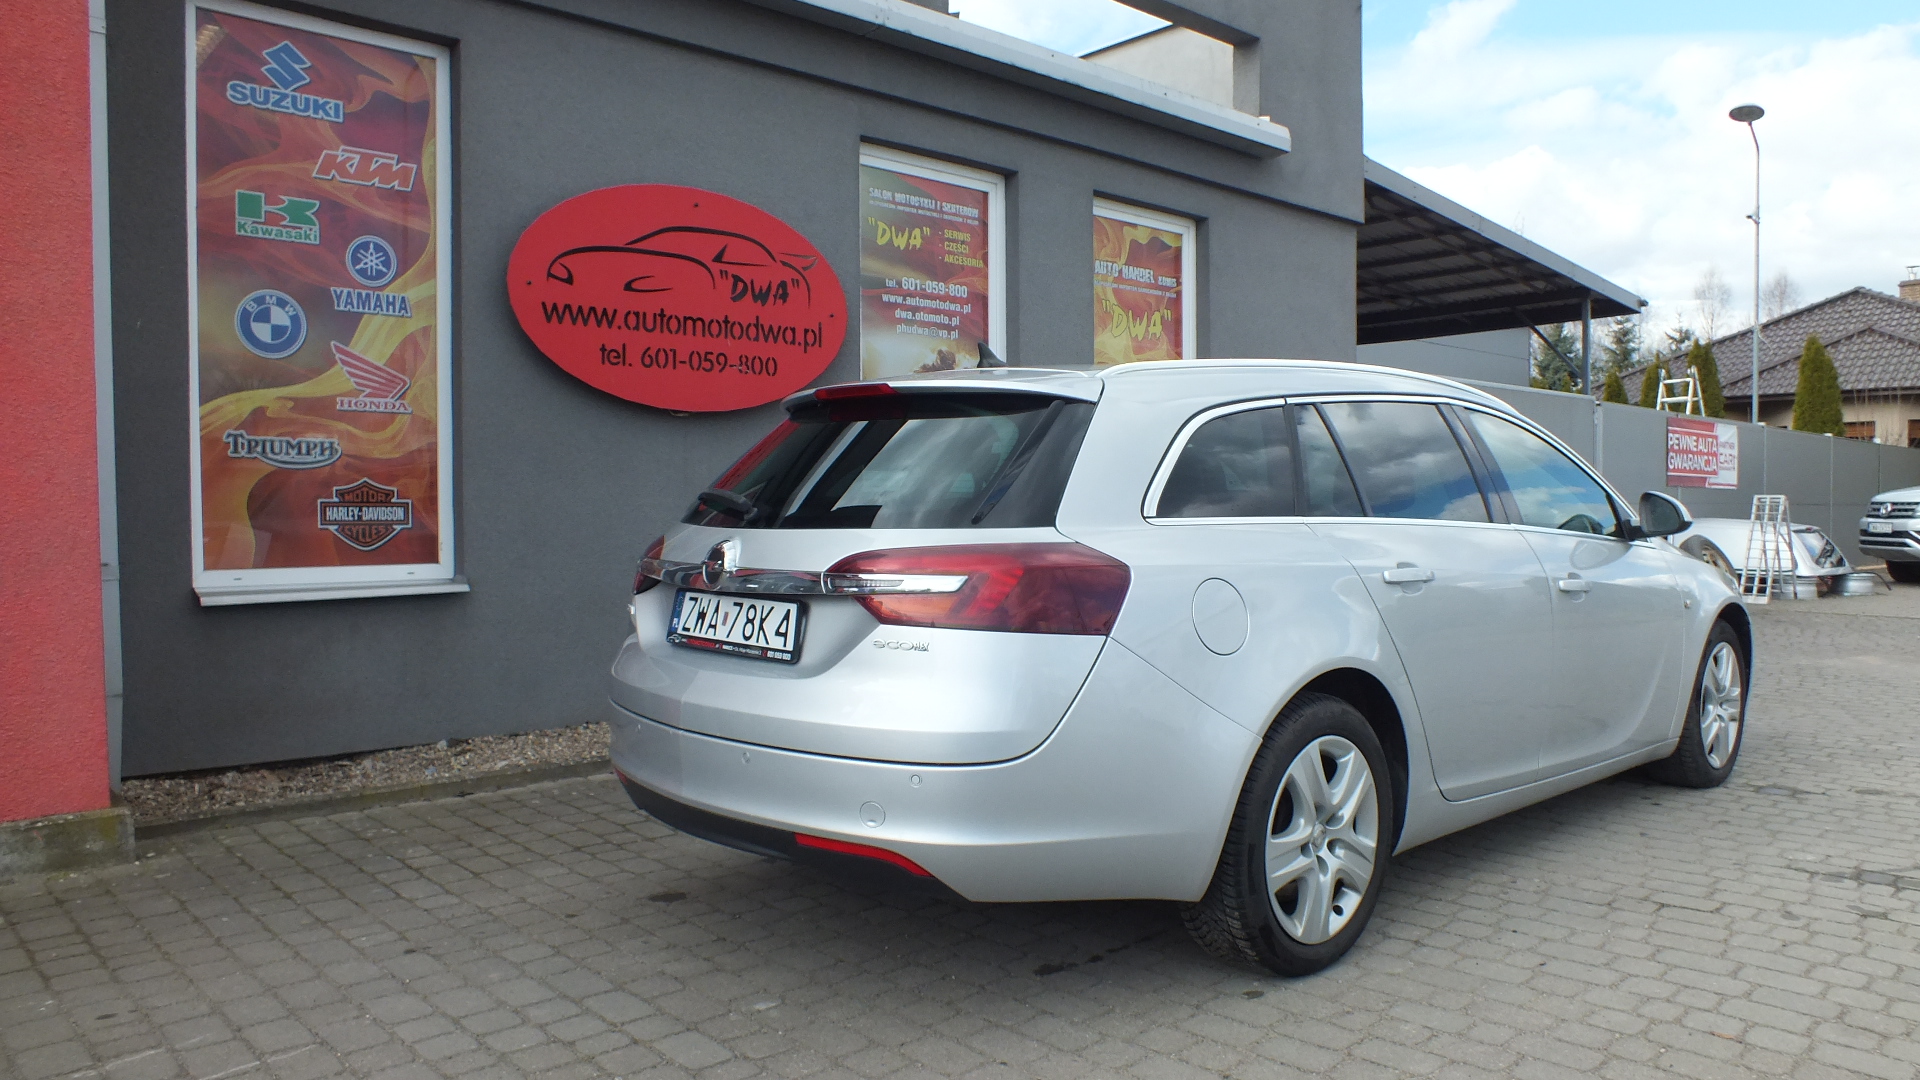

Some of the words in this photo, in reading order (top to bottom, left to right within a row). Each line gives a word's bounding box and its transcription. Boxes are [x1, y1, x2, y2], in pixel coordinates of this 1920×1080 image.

[227, 82, 343, 122] SUZUKI
[312, 146, 417, 191] KTM
[869, 187, 893, 201] SALON
[894, 192, 936, 210] MOTOCYKLI
[237, 221, 319, 243] Kawasaki
[867, 216, 930, 251] "DWA"
[944, 229, 971, 242] SERWIS
[944, 254, 984, 268] AKCESORIA
[1094, 260, 1119, 277] AUTO
[1122, 266, 1155, 284] HANDEL
[721, 270, 800, 307] "DWA"
[885, 278, 899, 288] tel.
[901, 276, 968, 298] 601-059-800
[245, 295, 297, 317] BMW
[331, 287, 411, 317] YAMAHA
[881, 293, 971, 314] www.automotodwa.pl
[541, 301, 822, 353] www.automotodwa.pl
[894, 308, 960, 327] dwa.otomoto.pl
[1102, 298, 1172, 341] "DWA"
[896, 323, 959, 340] phudwa@vp.pl
[600, 343, 632, 368] tel.
[640, 347, 778, 377] 601-059-800
[337, 398, 411, 412] HONDA
[224, 430, 341, 458] TRIUMPH
[1668, 434, 1697, 452] PEWNE
[1698, 438, 1717, 453] AUTA
[1668, 453, 1717, 472] GWARANCJA
[344, 488, 386, 502] MOTOR
[326, 506, 404, 521] HARLEY-DAVIDSON
[344, 525, 386, 542] CYCLES
[682, 597, 722, 637] ZWA
[726, 602, 792, 648] 78K4
